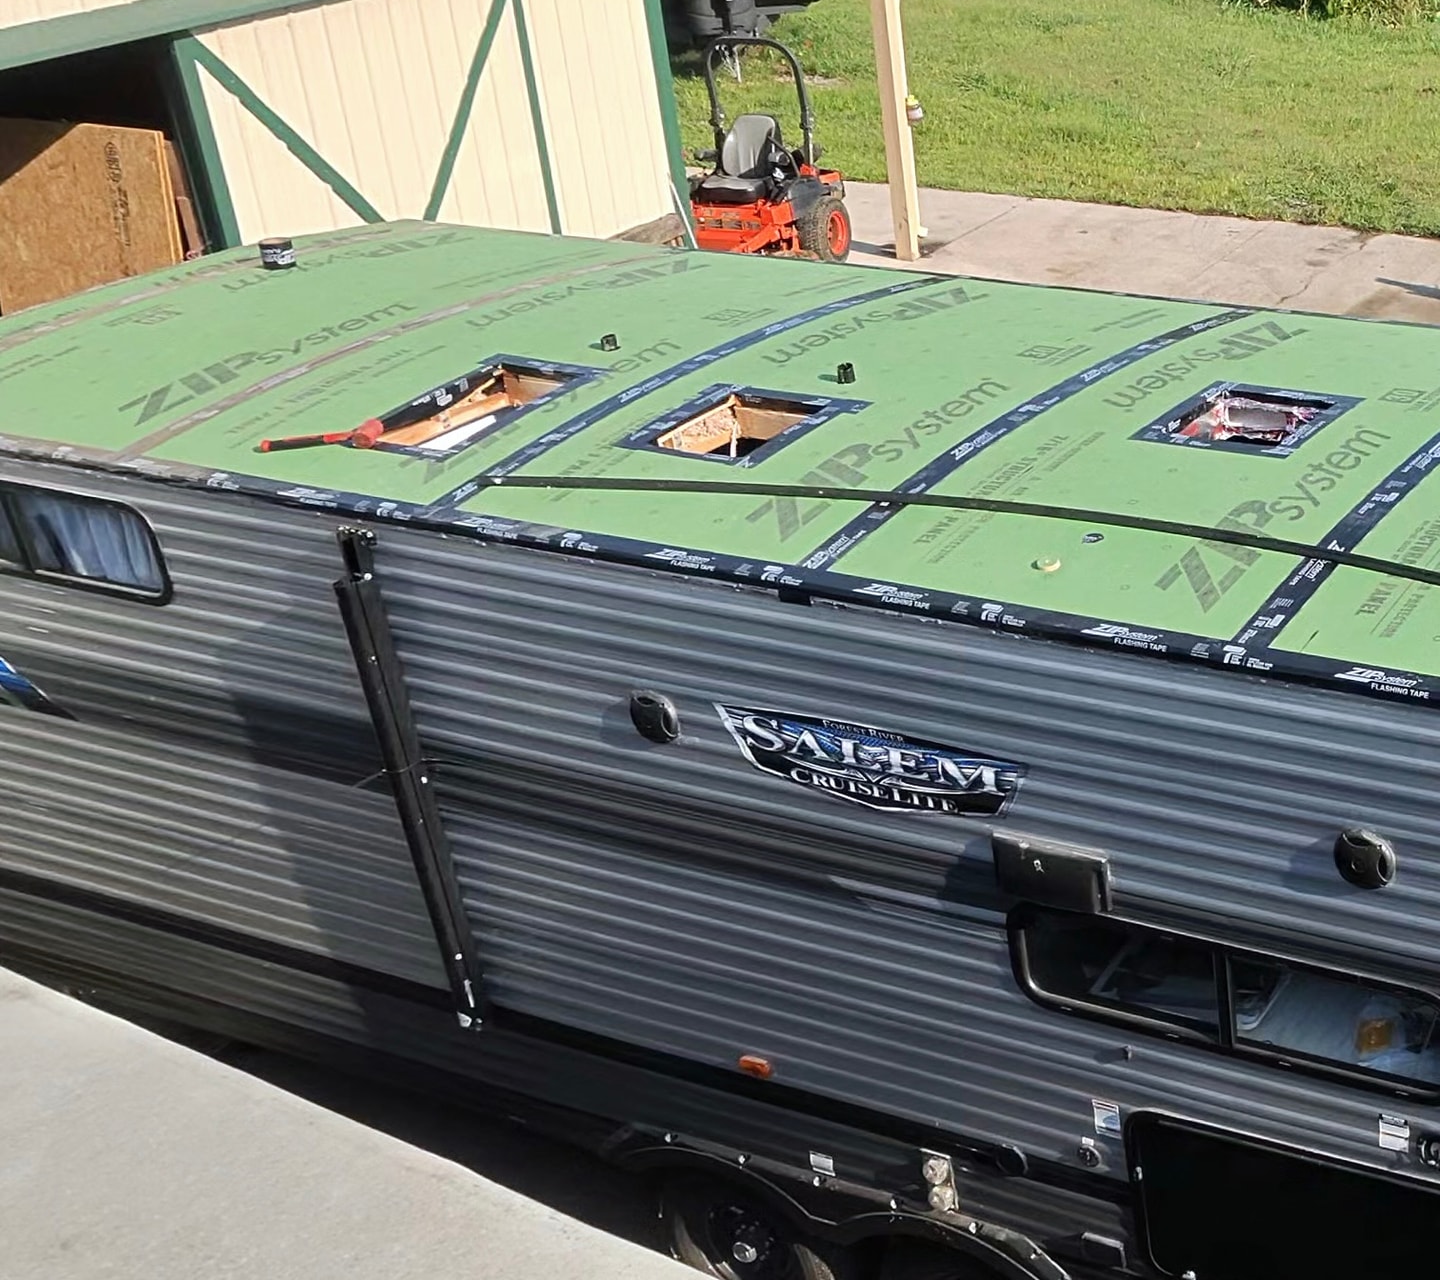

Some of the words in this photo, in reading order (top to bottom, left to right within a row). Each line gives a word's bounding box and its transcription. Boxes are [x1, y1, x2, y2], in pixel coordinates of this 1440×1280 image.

[1113, 637, 1149, 650] FLASHING
[1149, 643, 1168, 653] TAPE
[1370, 683, 1409, 696] FLASHING
[1410, 689, 1430, 700] TAPE
[742, 715, 1005, 795] SALEM
[790, 768, 890, 801] CRUISE
[891, 784, 960, 814] LITE
